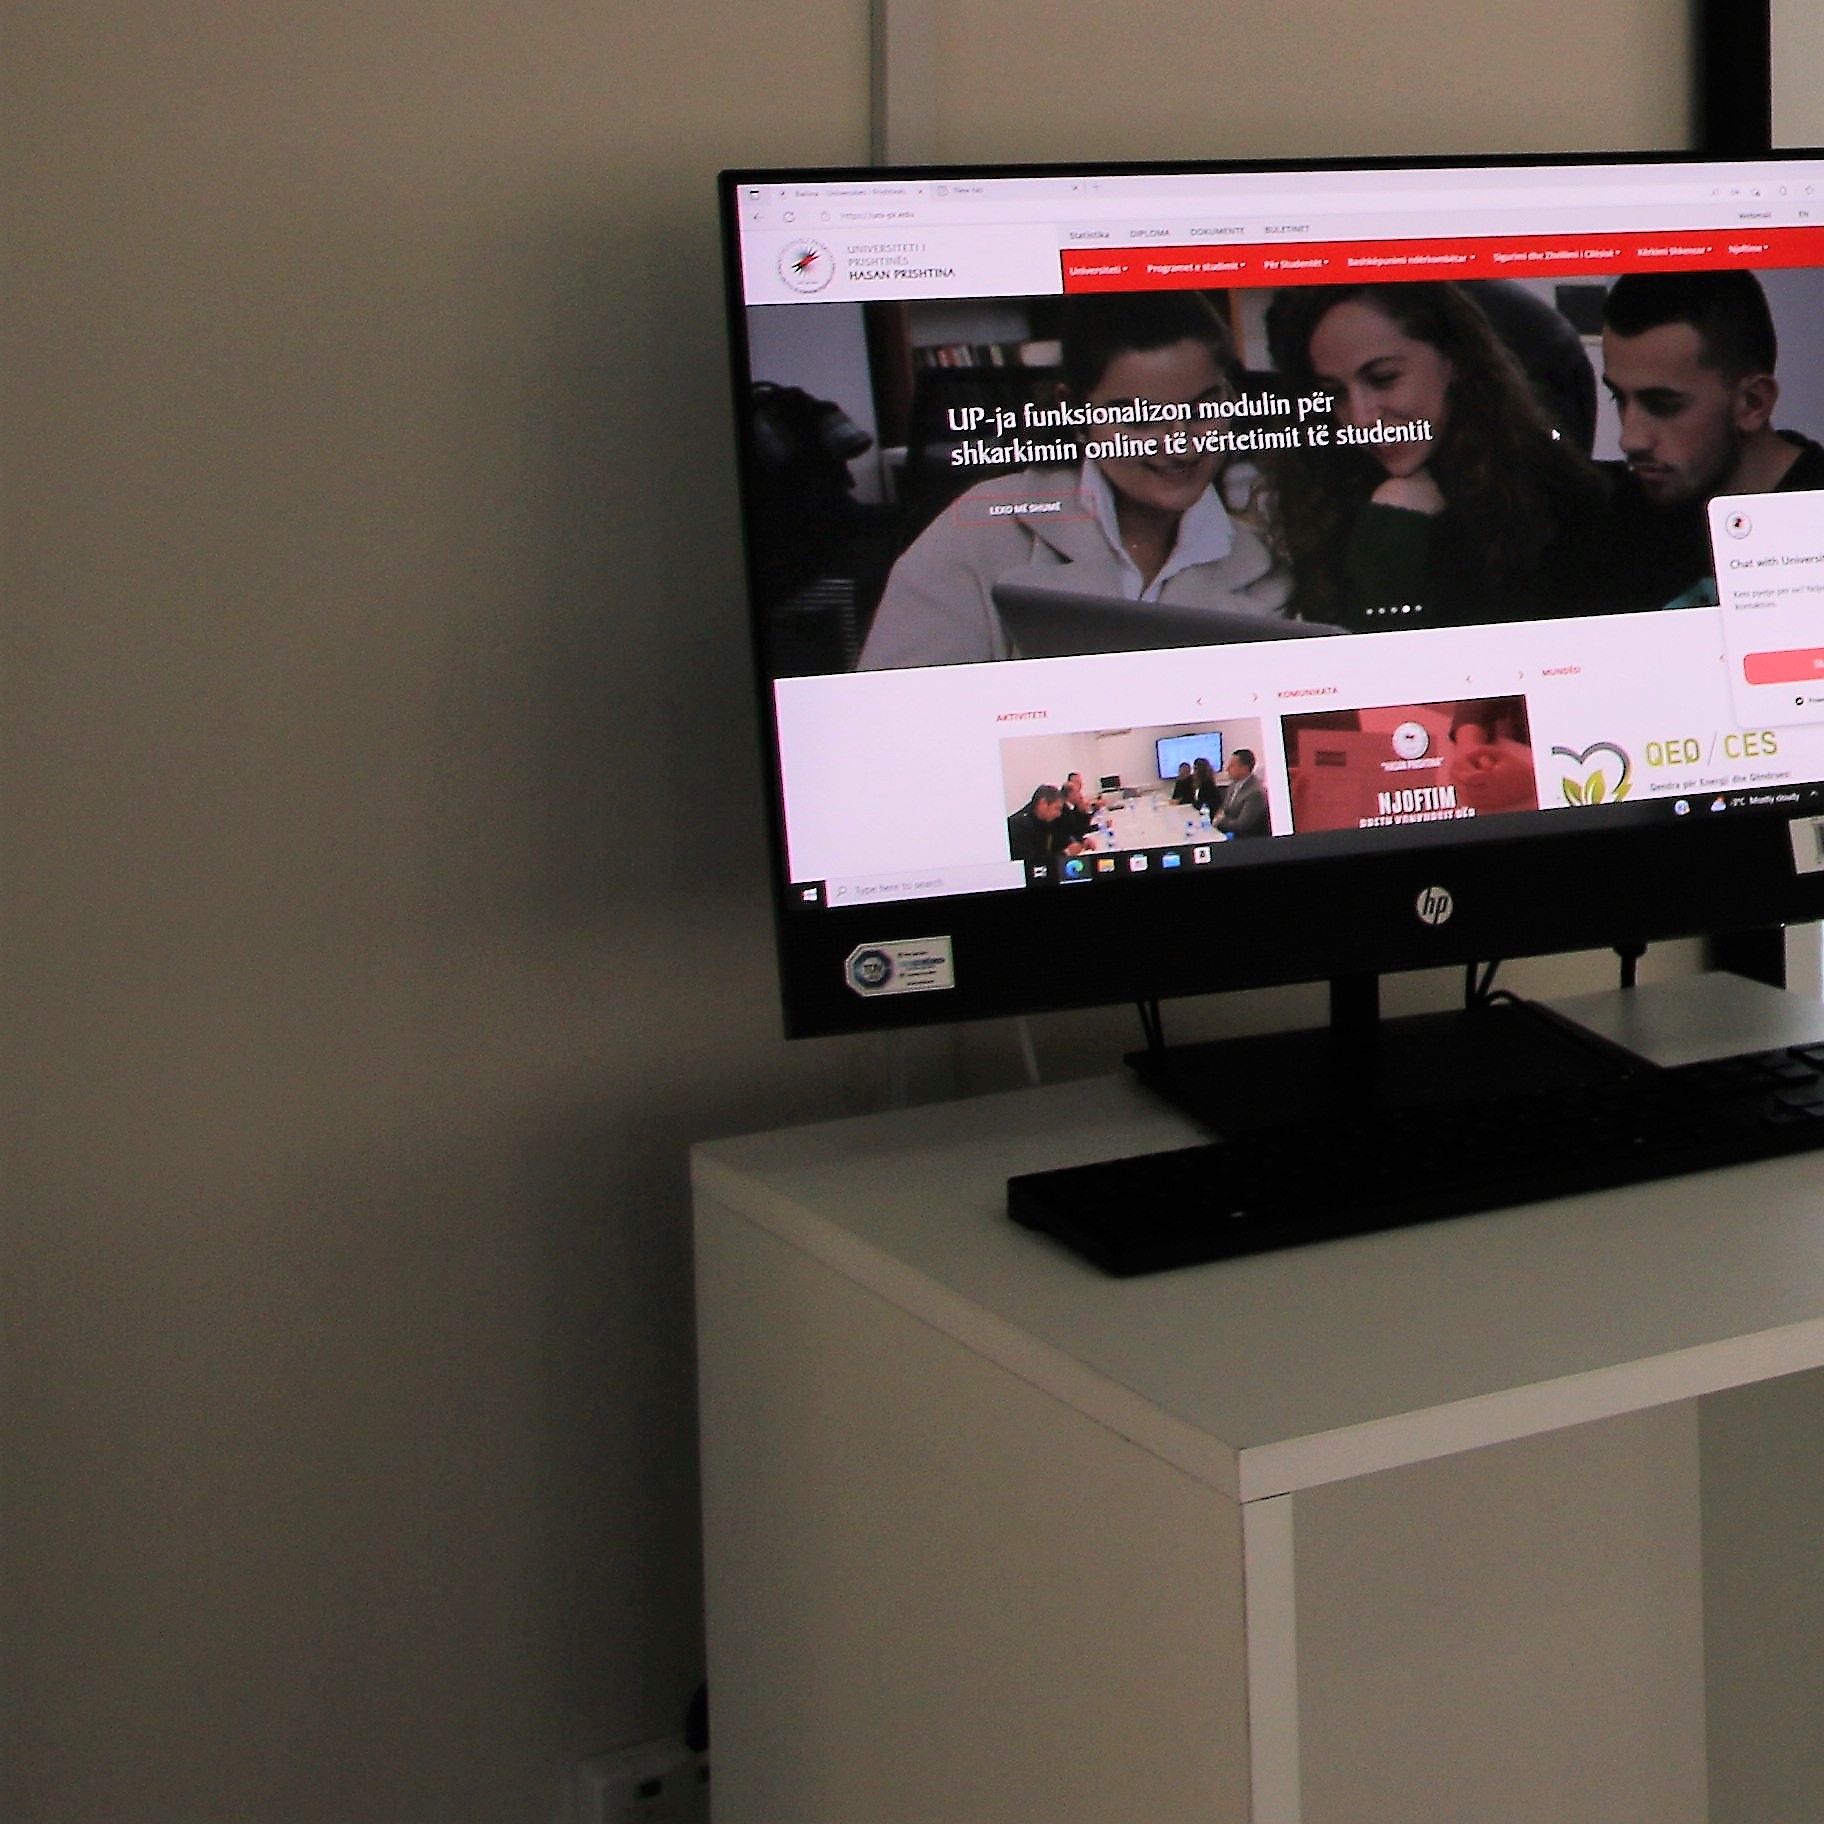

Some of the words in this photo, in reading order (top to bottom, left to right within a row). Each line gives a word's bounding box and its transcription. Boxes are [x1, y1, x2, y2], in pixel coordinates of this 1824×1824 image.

[847, 243, 919, 254] UNIVERSITETI
[850, 269, 890, 281] HASAN
[893, 266, 956, 280] PRISHTINA
[946, 405, 1018, 439] UP-ja
[1022, 398, 1192, 429] funksionalizon
[1198, 394, 1291, 420] modulin
[1296, 392, 1334, 423] për
[950, 435, 1078, 467] shkarkimin
[1084, 431, 1159, 460] online
[1163, 428, 1189, 455] të
[1192, 425, 1302, 453] vërtetimit
[1307, 423, 1330, 448] të
[1336, 418, 1434, 446] studentit
[1730, 558, 1754, 570] Chat
[1756, 557, 1779, 567] with
[1276, 686, 1339, 699] KOMUNIKATA
[996, 710, 1048, 723] AKTIVITETE
[1723, 730, 1778, 759] CES
[1378, 785, 1457, 815] NJOFTIM
[855, 885, 878, 897] Type
[1422, 887, 1449, 924] hp
